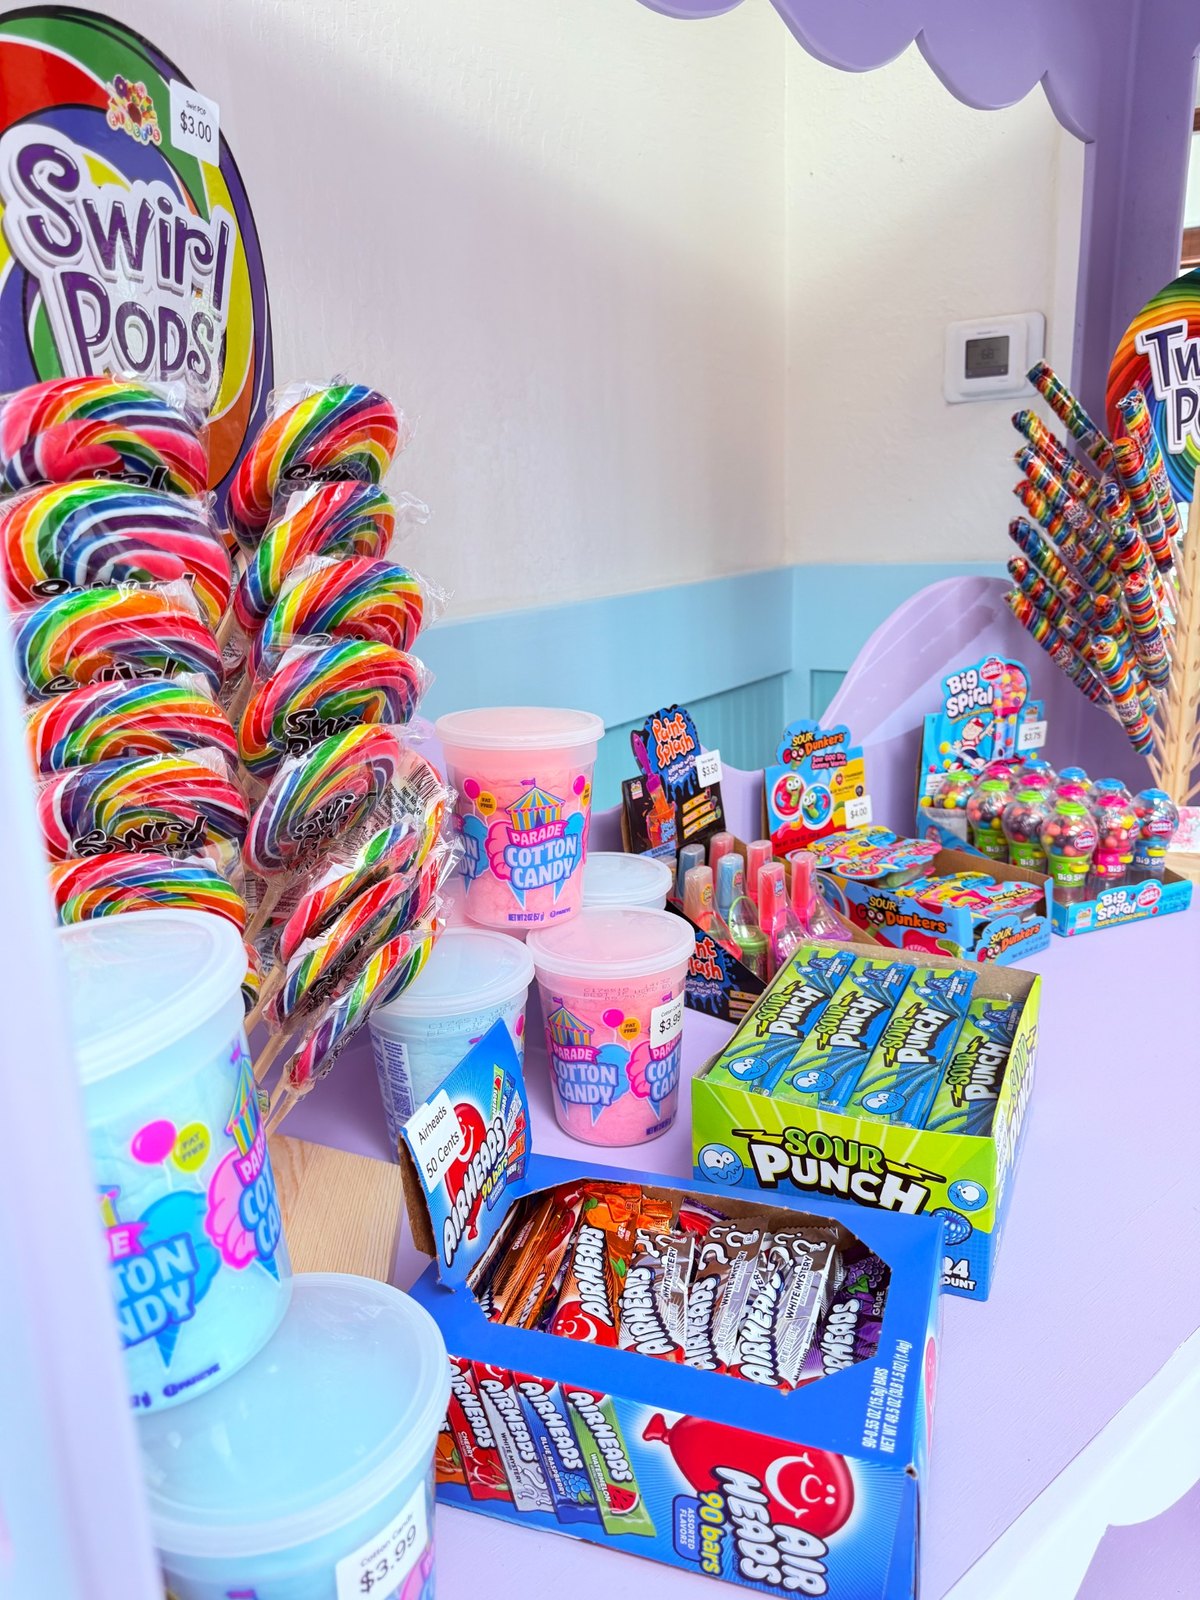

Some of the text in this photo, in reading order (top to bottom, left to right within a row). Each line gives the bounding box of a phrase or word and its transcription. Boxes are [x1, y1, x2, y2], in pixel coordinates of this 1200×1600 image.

[180, 110, 212, 142] $3.00
[16, 142, 229, 312] Swirl
[946, 669, 979, 695] Big
[945, 684, 994, 719] Spiral
[652, 712, 687, 744] Paint
[791, 732, 814, 747] SOUR
[805, 732, 845, 756] Dunkers
[656, 730, 695, 769] Splash
[511, 823, 563, 846] PARADE
[504, 836, 578, 868] COTTON
[513, 857, 574, 889] CANDY
[868, 895, 898, 913] SOUR
[1096, 901, 1137, 922] Spiral
[1100, 890, 1127, 907] Big
[885, 910, 947, 934] Dunkers
[989, 926, 1013, 944] SOUR
[1000, 923, 1041, 954] Dunkers
[688, 956, 724, 981] lash
[659, 1010, 682, 1035] $3.99
[757, 993, 792, 1022] SOUR
[768, 984, 826, 1037] PUNCH
[818, 1004, 850, 1035] SOUR
[829, 995, 887, 1048] PUNCH
[882, 1017, 916, 1049] SOUR
[897, 1006, 951, 1063] PUNCH
[949, 1051, 978, 1086] SOUR
[964, 1041, 1011, 1101] PUNCH
[558, 1078, 614, 1105] CANDY
[181, 1131, 201, 1150] FAT
[417, 1105, 448, 1146] Airheads
[181, 1140, 206, 1163] FREE
[425, 1129, 461, 1180] 50 Cents
[783, 1128, 886, 1173] SOUR
[443, 1116, 506, 1267] AIRHEADS
[481, 1176, 493, 1201] 90
[492, 1156, 508, 1186] bars
[749, 1141, 929, 1216] PUNCH
[113, 1238, 195, 1300] TON
[942, 1275, 977, 1291] OUNT
[721, 1279, 735, 1307] WHITE
[786, 1287, 800, 1320] WHITE
[795, 1255, 814, 1288] MYSTERY
[119, 1280, 193, 1342] NDY
[872, 1366, 889, 1386] BARS
[866, 1408, 881, 1419] OZ
[883, 1407, 900, 1424] 49.5
[886, 1397, 901, 1408] OZ
[480, 1379, 539, 1464] AIRHEADS
[518, 1381, 583, 1470] AIRHEADS
[567, 1391, 634, 1483] AIRHEADS
[882, 1422, 897, 1436] WT
[461, 1431, 474, 1458] CHERRY
[501, 1432, 523, 1484] WHITE MYSTERY
[878, 1435, 896, 1453] NET
[540, 1436, 567, 1497] BLUE RASPBERRY
[589, 1453, 612, 1503] WATERMELON
[679, 1508, 688, 1545] FLAVORS
[687, 1507, 696, 1550] ASSORTED
[700, 1491, 724, 1576] 90 bars
[714, 1466, 783, 1585] HEADS
[360, 1524, 417, 1595] $3.99
[772, 1523, 828, 1596] AIR
